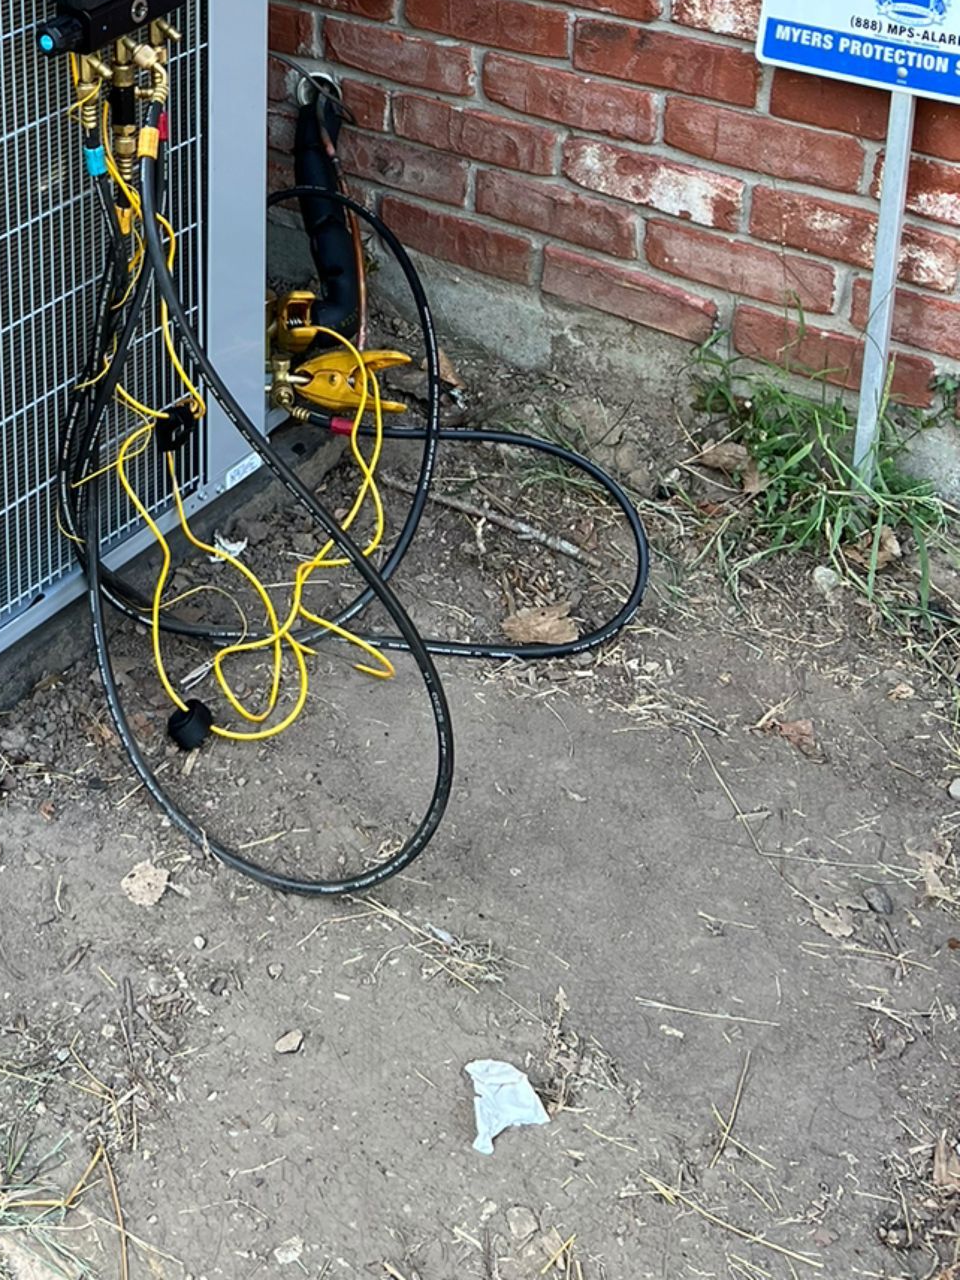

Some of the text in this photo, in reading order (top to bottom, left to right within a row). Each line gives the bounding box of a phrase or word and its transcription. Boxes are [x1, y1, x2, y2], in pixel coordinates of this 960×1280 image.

[775, 24, 834, 50] MYERS
[838, 36, 950, 73] PROTECTION
[850, 15, 883, 33] (888)
[887, 23, 960, 47] MPS-ALAR
